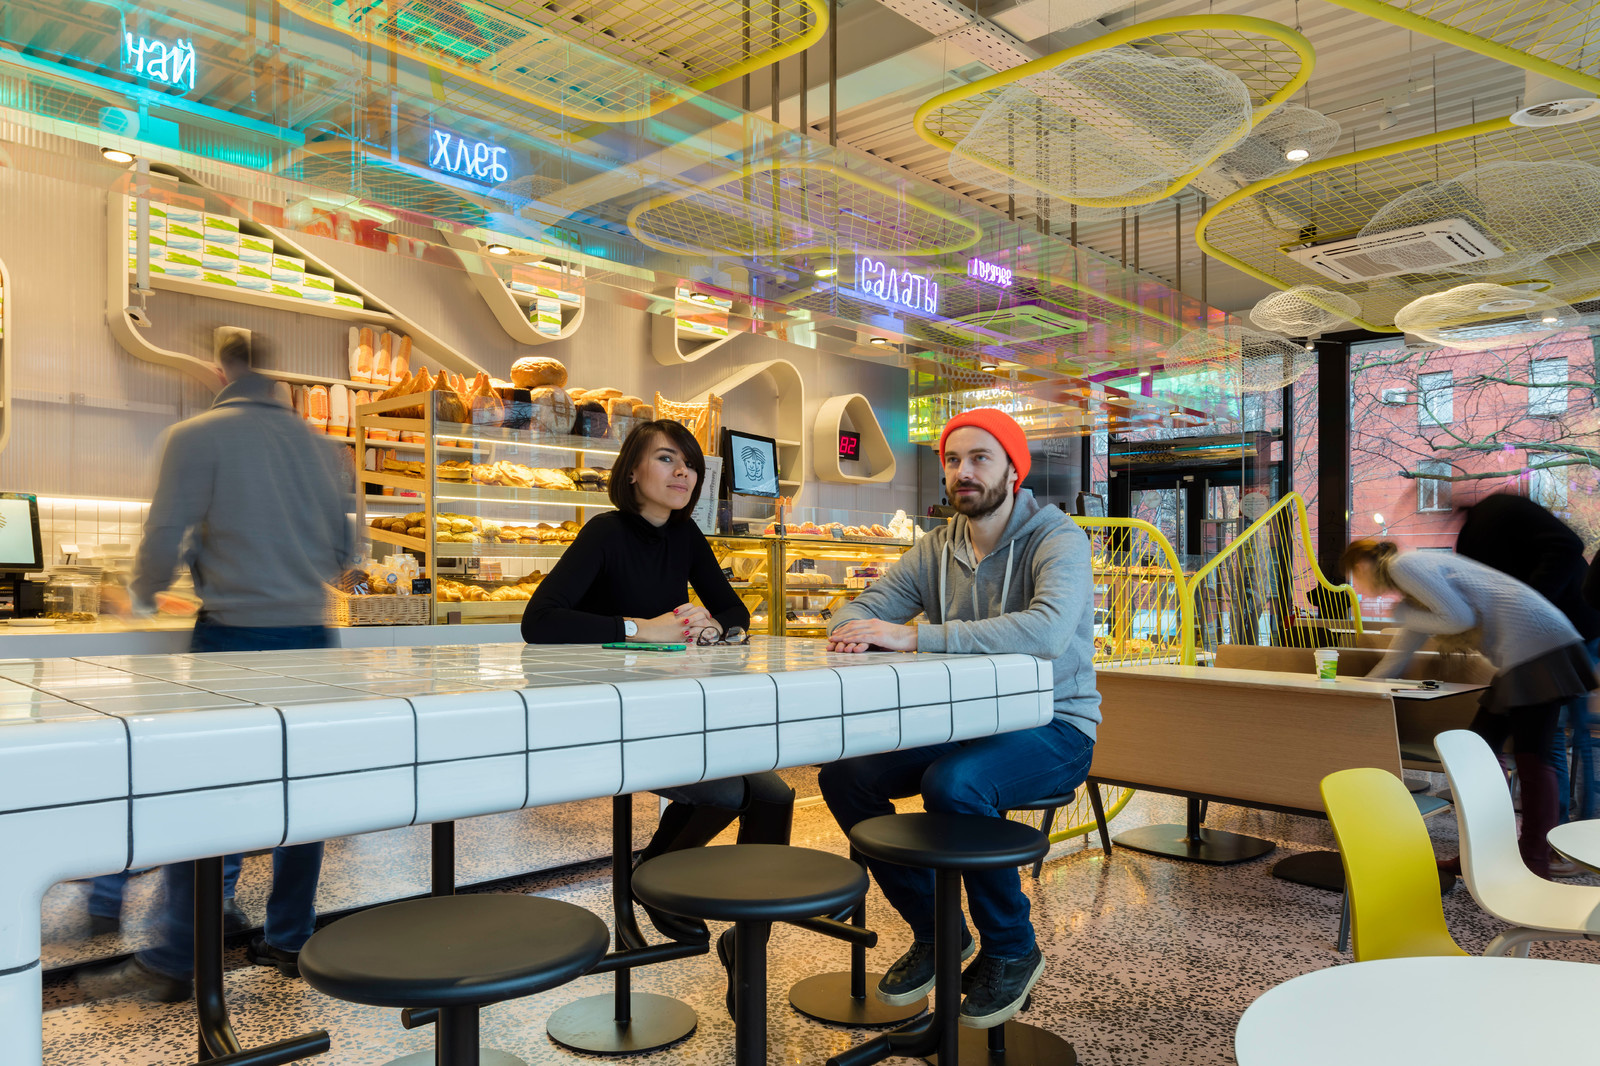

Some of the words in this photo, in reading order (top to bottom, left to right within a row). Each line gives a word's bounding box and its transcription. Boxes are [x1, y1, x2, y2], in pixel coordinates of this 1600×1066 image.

[433, 129, 508, 182] хлеб
[861, 257, 938, 314] салаты
[839, 436, 857, 455] 82
